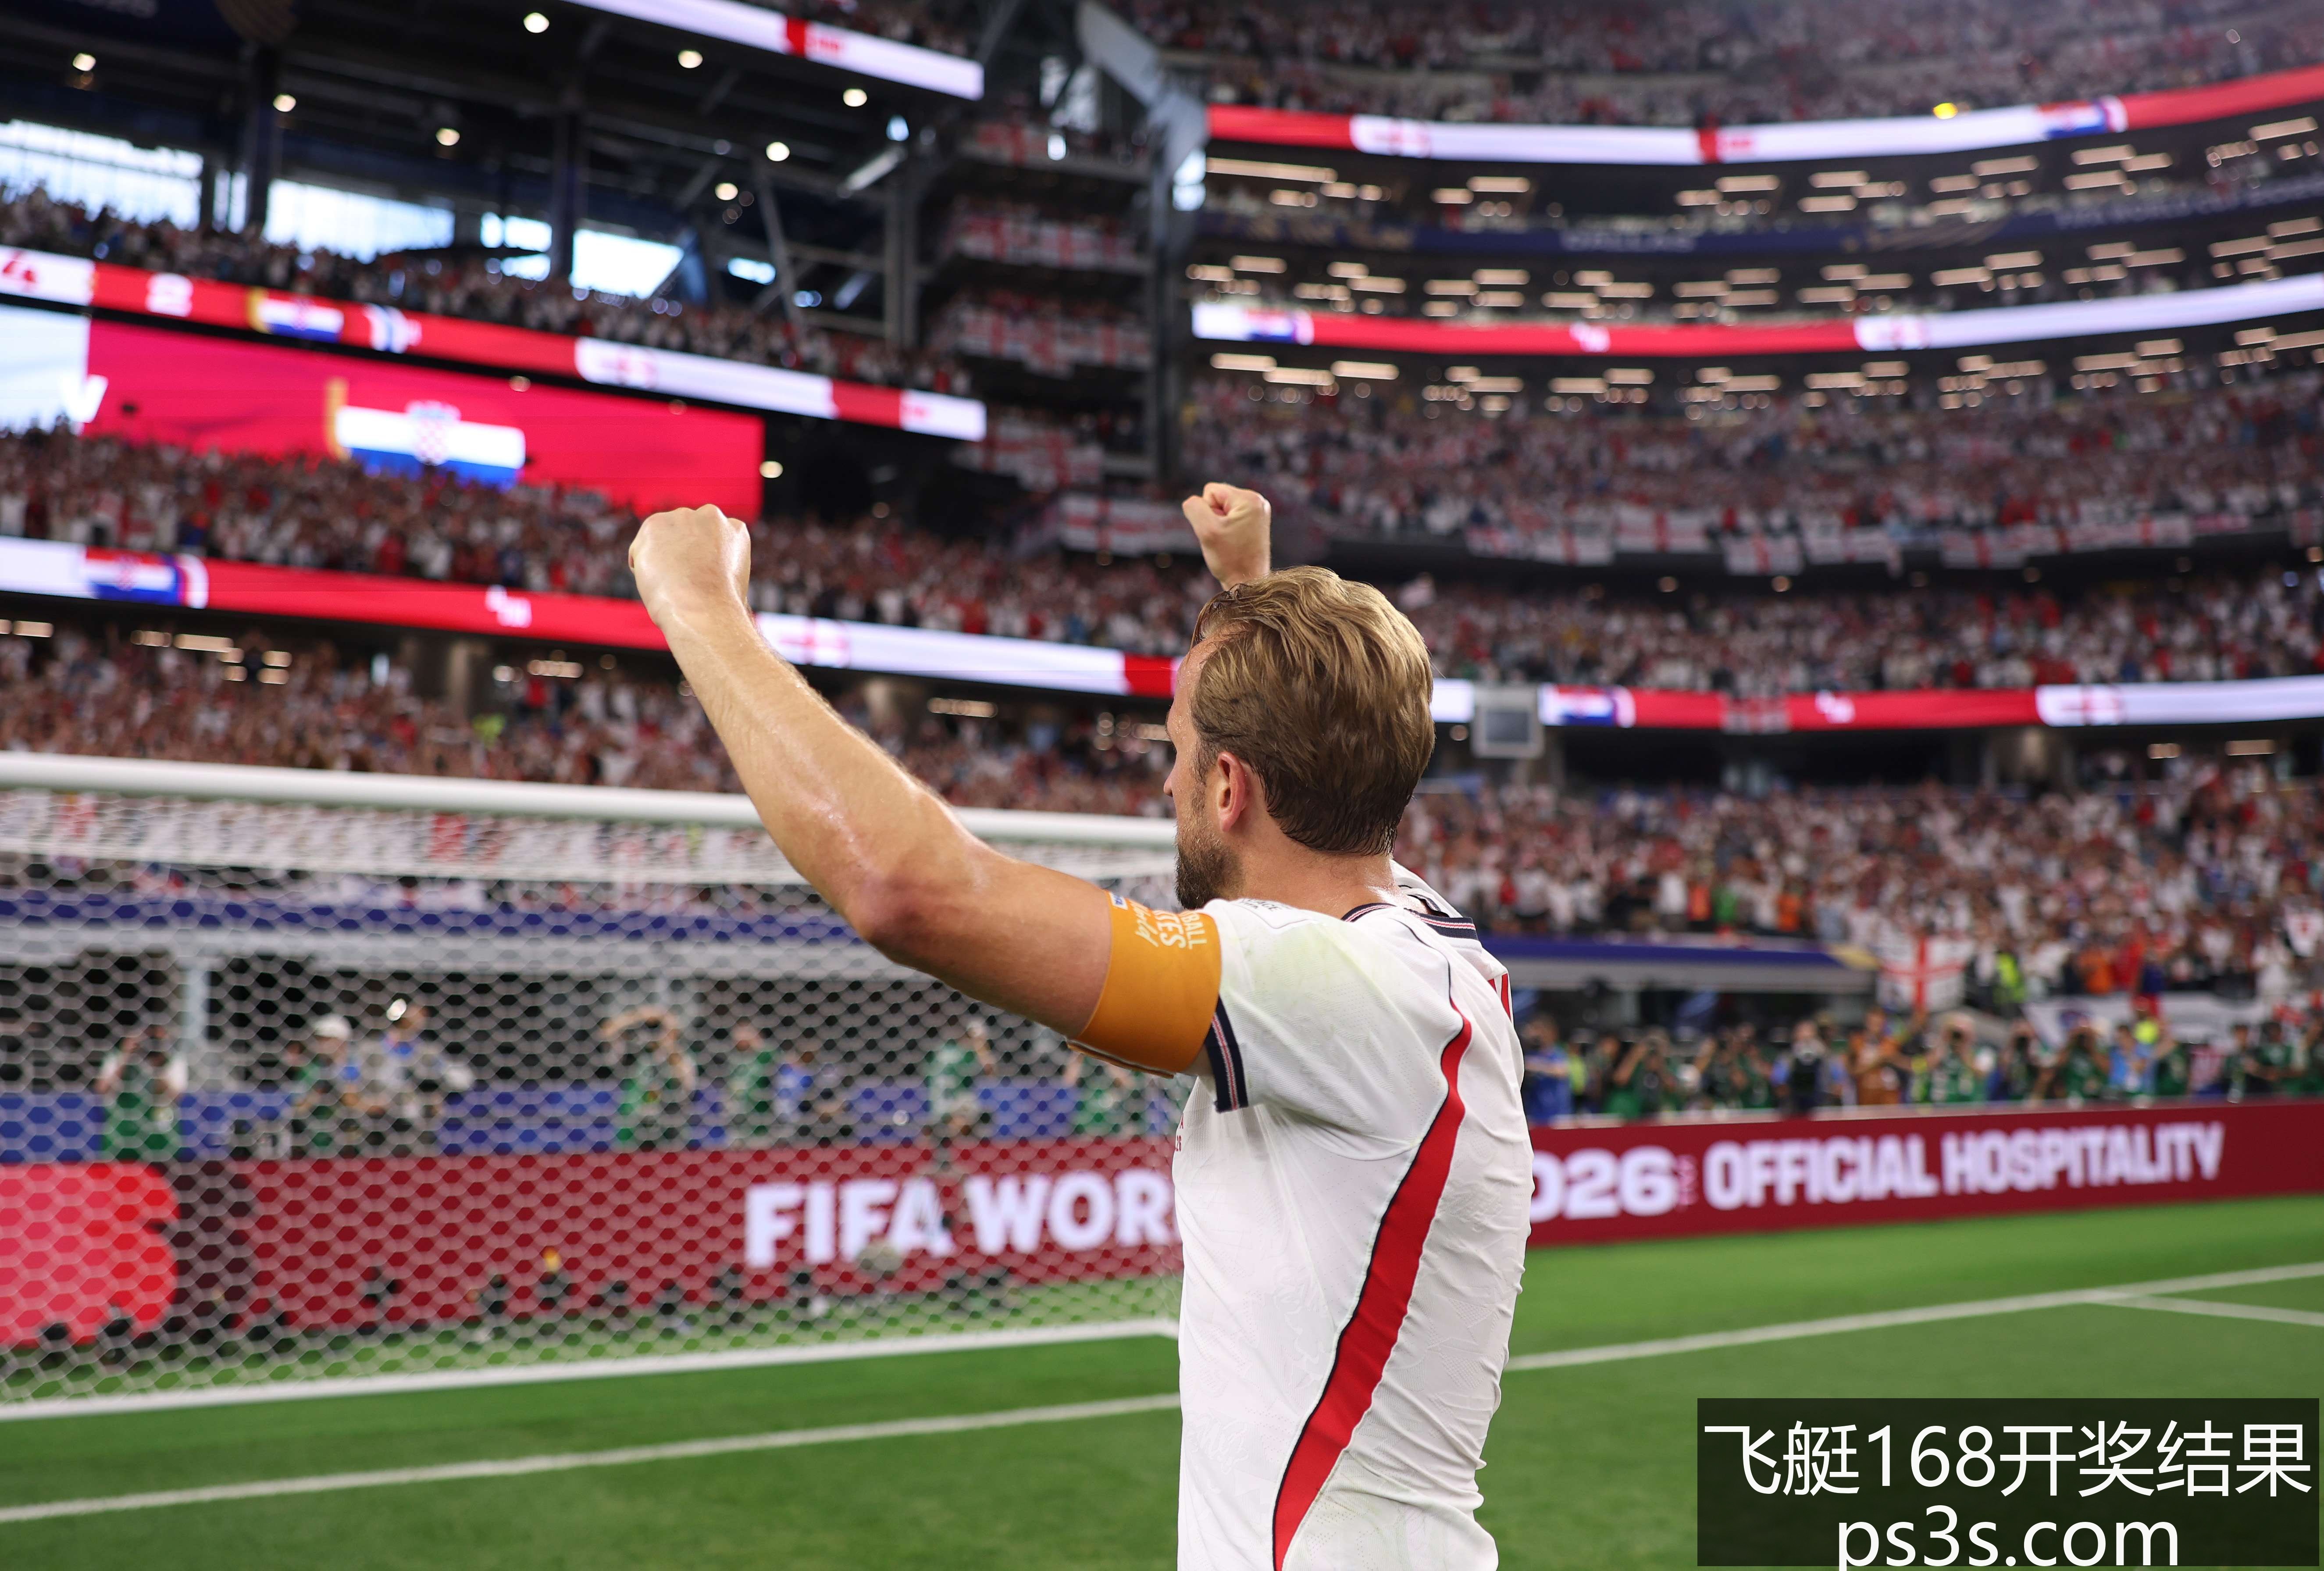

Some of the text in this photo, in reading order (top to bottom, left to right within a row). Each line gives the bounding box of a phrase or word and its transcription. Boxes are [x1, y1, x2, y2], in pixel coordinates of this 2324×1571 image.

[745, 1177, 953, 1268] FIFA
[965, 1168, 1180, 1254] WOR
[1529, 1145, 1679, 1223] 026
[1704, 1136, 1939, 1209] OFFICIAL
[1942, 1122, 2224, 1193] HOSPITALITY
